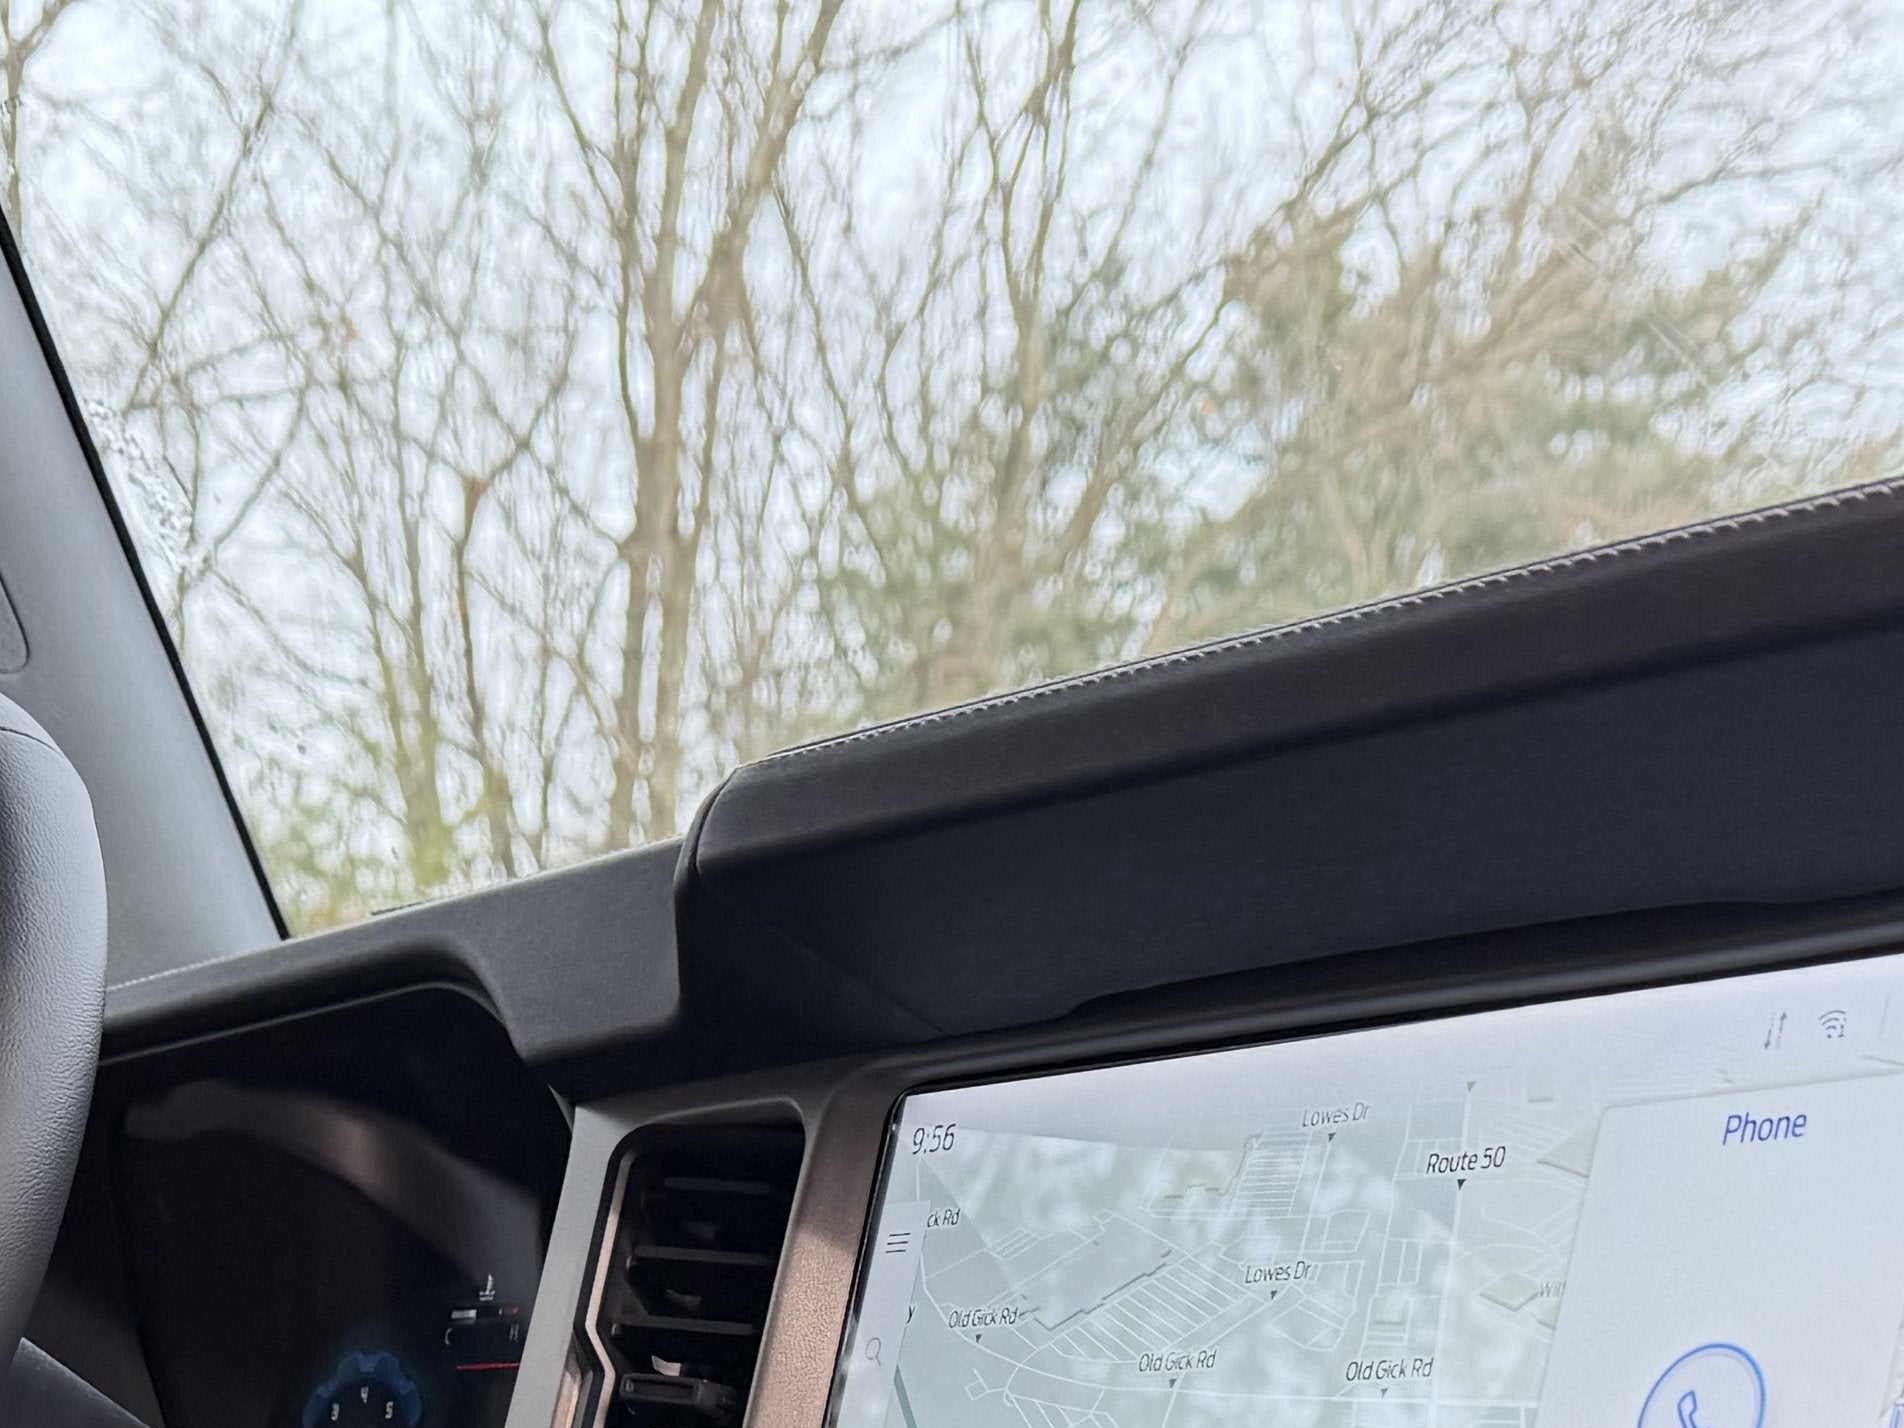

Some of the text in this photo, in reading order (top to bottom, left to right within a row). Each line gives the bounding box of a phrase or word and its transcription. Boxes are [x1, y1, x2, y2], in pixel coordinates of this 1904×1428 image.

[1302, 1102, 1369, 1128] Lowes Dr
[912, 1123, 956, 1155] 9:56
[1722, 1111, 1807, 1145] Phone
[1425, 1145, 1507, 1174] Route 50
[943, 1207, 960, 1226] Rd
[1245, 1261, 1312, 1284] Lowes Dr
[949, 1309, 971, 1328] Old
[999, 1306, 1018, 1325] Rd
[1138, 1350, 1217, 1372] Old Gick Rd
[1346, 1357, 1434, 1381] Old Gick Rd
